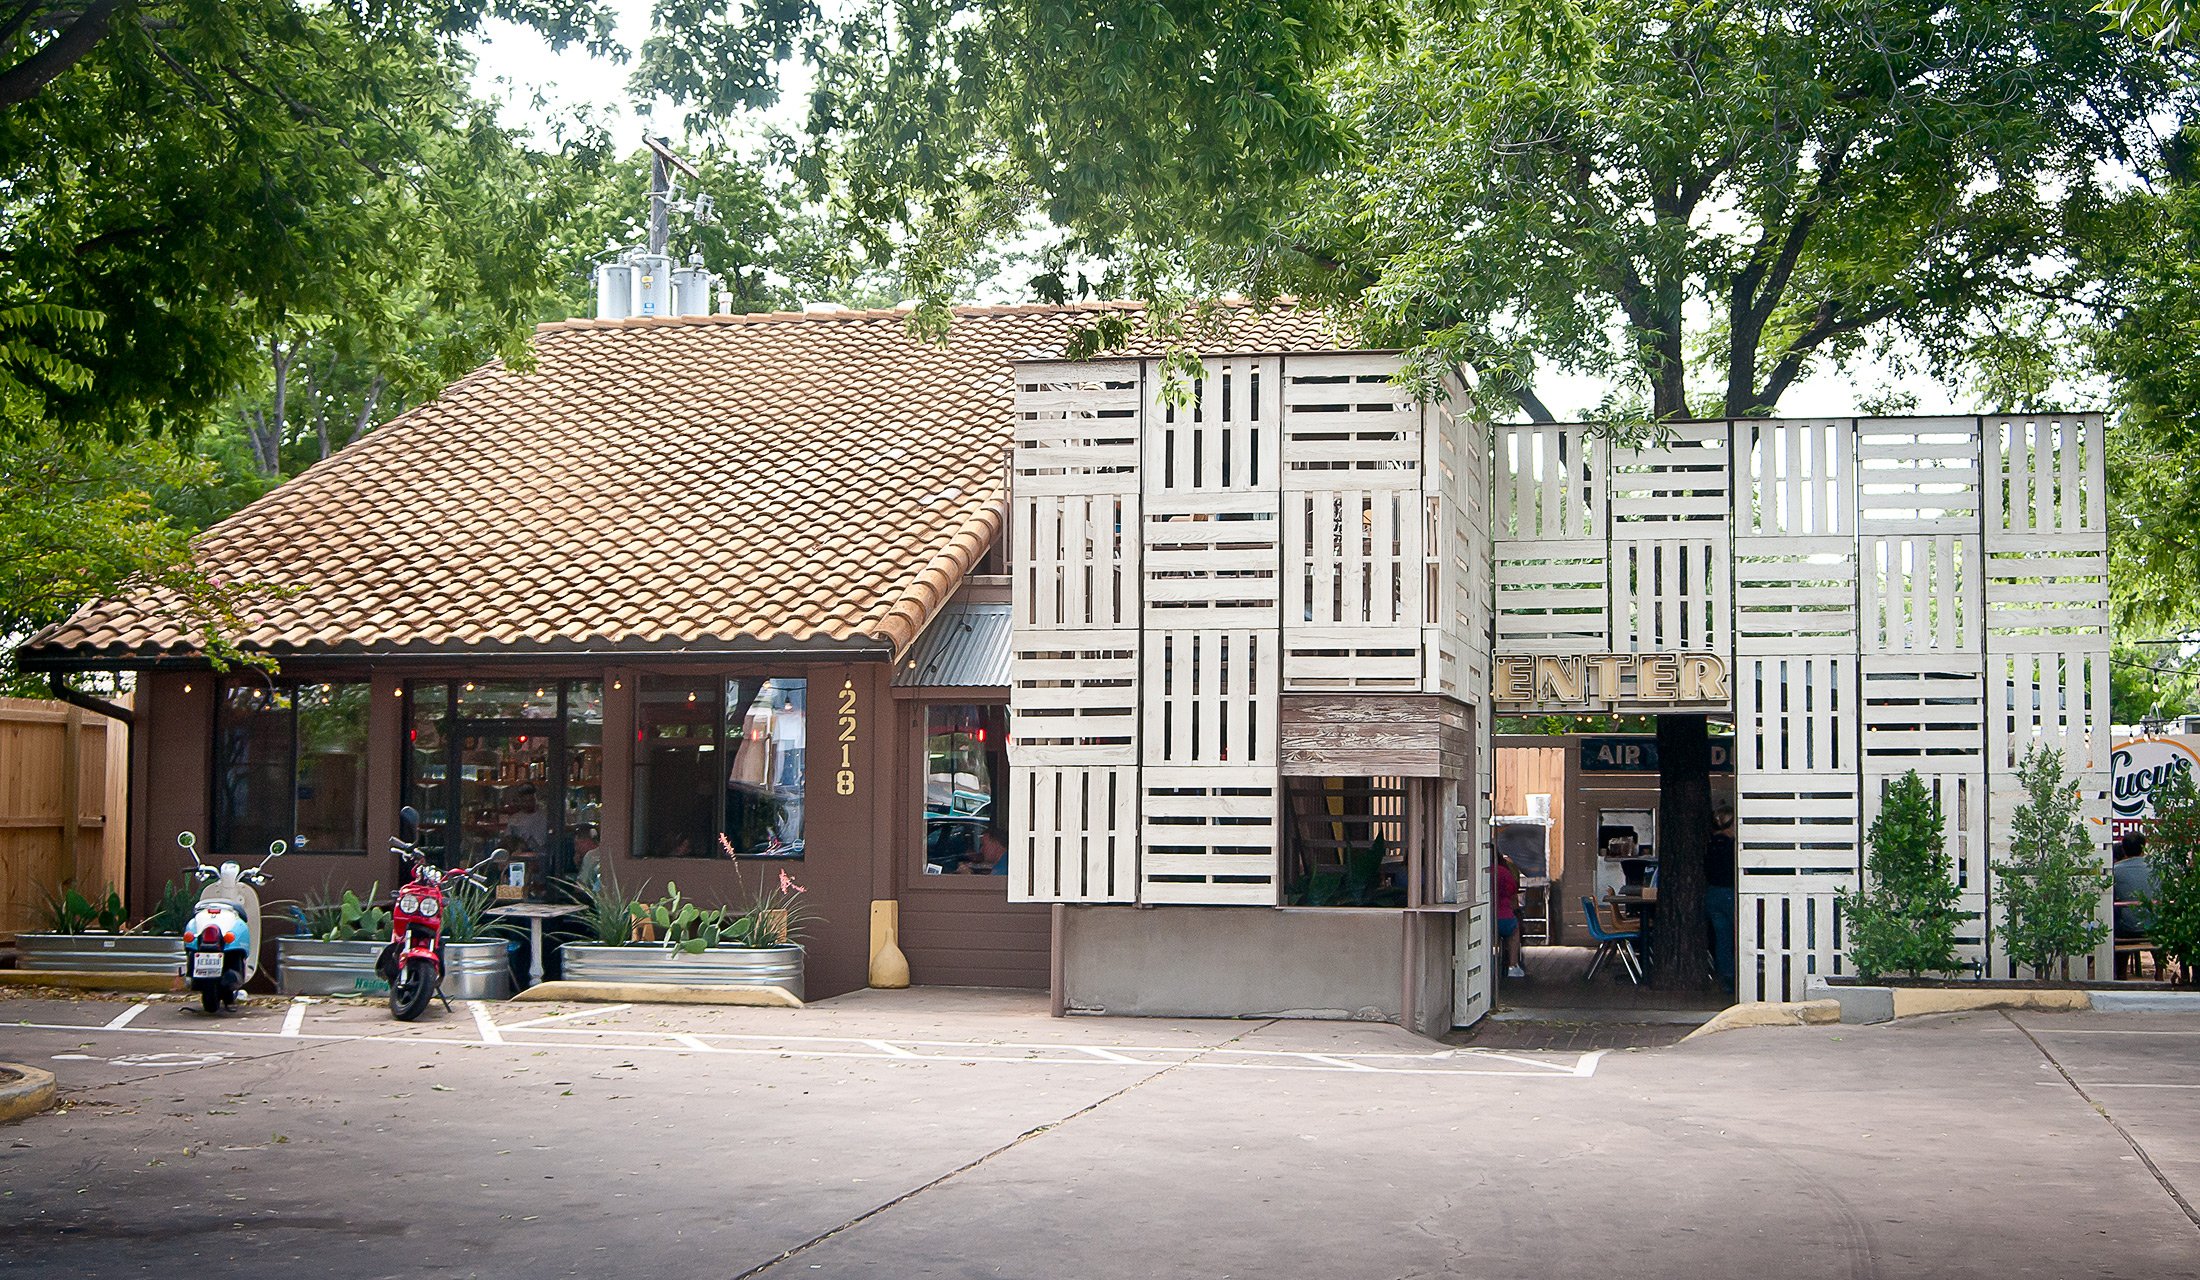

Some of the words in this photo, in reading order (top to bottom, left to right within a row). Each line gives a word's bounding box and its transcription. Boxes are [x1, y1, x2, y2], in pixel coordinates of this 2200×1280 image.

[1494, 652, 1730, 703] ENTER
[837, 690, 856, 795] 2218
[1597, 745, 1640, 765] AIR
